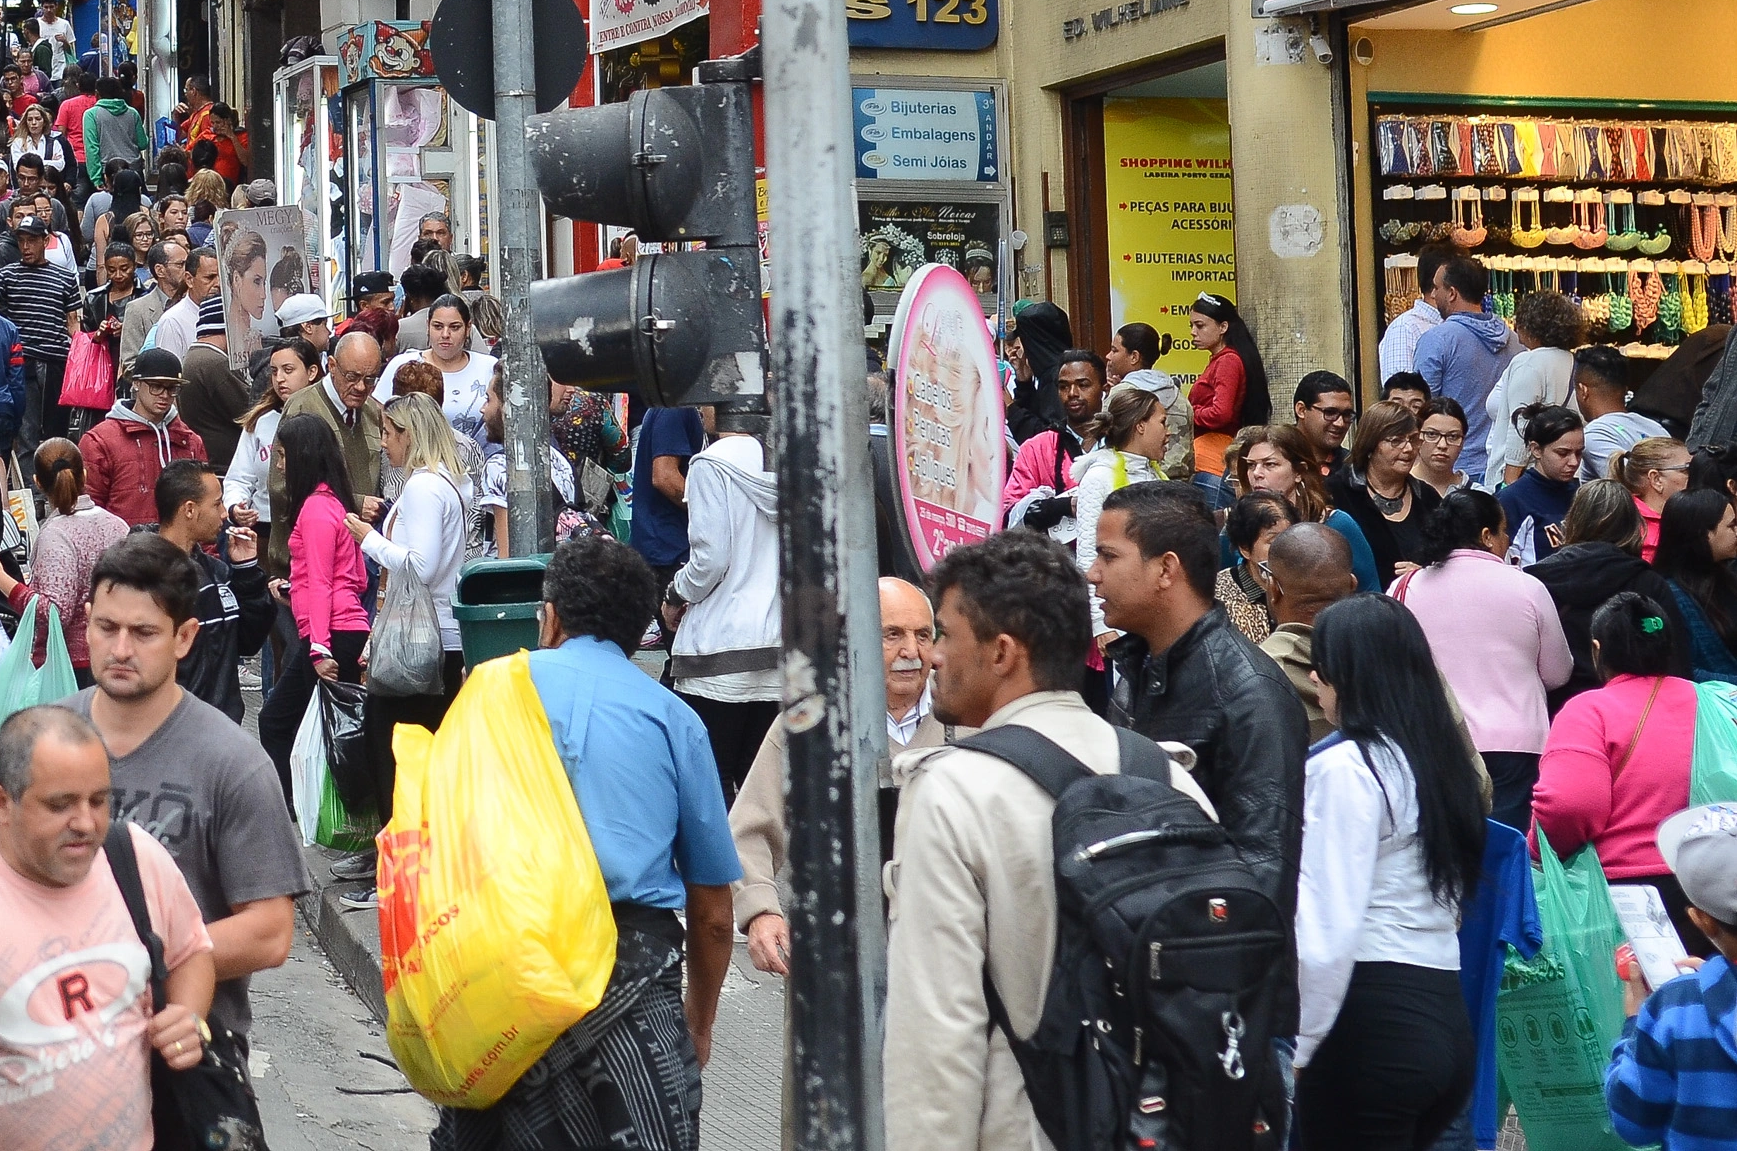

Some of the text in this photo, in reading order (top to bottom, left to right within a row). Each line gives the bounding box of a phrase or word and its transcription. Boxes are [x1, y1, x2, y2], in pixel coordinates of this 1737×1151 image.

[891, 100, 957, 116] Bijuterias
[891, 126, 976, 144] Embalagens
[985, 114, 993, 160] ANDAR
[893, 154, 967, 169] Semi Jóias
[1120, 158, 1193, 169] SHOPPING
[1130, 201, 1170, 216] PEÇAS
[1173, 202, 1206, 213] PARA
[256, 209, 292, 227] MEGY
[1171, 215, 1232, 230] ACESSÓRI
[926, 231, 966, 242] Sobreloja
[1135, 253, 1234, 265] BIJUTERIAS NAC
[913, 370, 952, 411] Cabelos
[913, 411, 952, 448] Perucas
[912, 447, 956, 492] Apliques
[57, 972, 94, 1022] R
